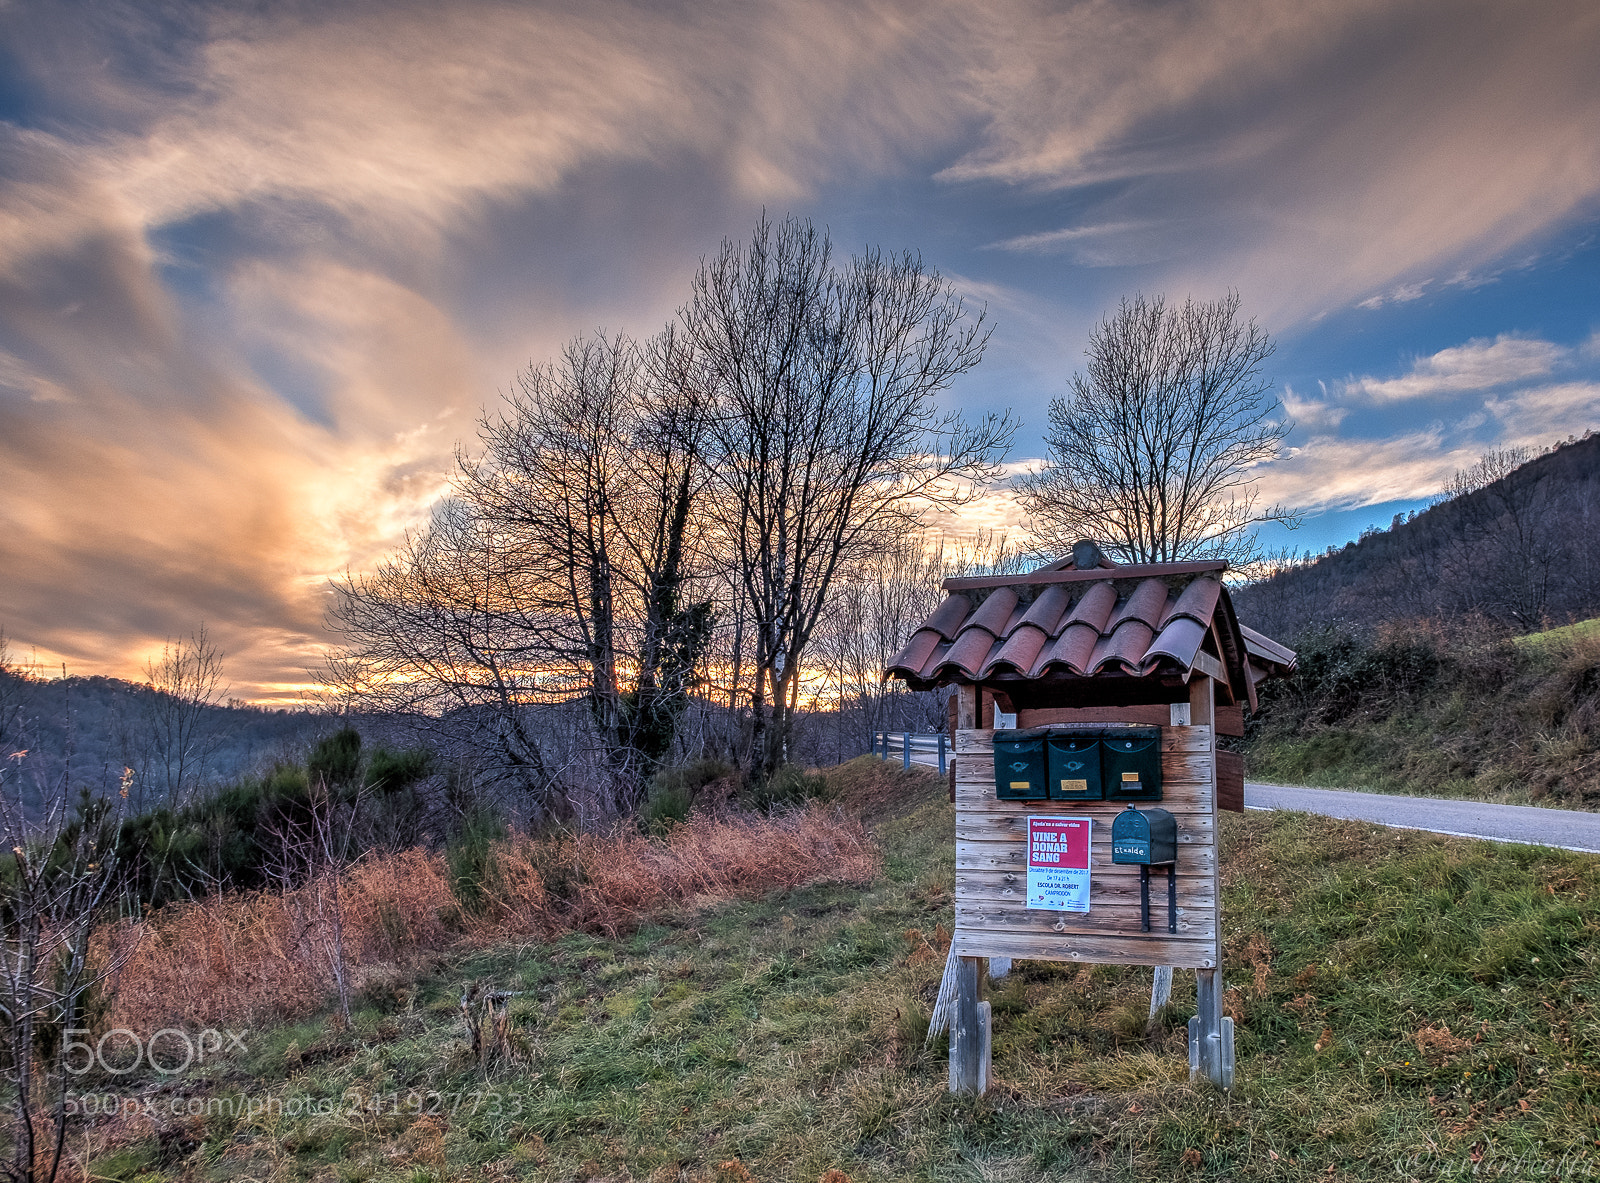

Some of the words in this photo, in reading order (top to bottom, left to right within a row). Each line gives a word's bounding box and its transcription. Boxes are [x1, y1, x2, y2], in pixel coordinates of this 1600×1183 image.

[1032, 832, 1058, 842] VINE
[1060, 832, 1067, 842] A
[1032, 842, 1068, 852] DONAR
[1032, 852, 1060, 862] SANG
